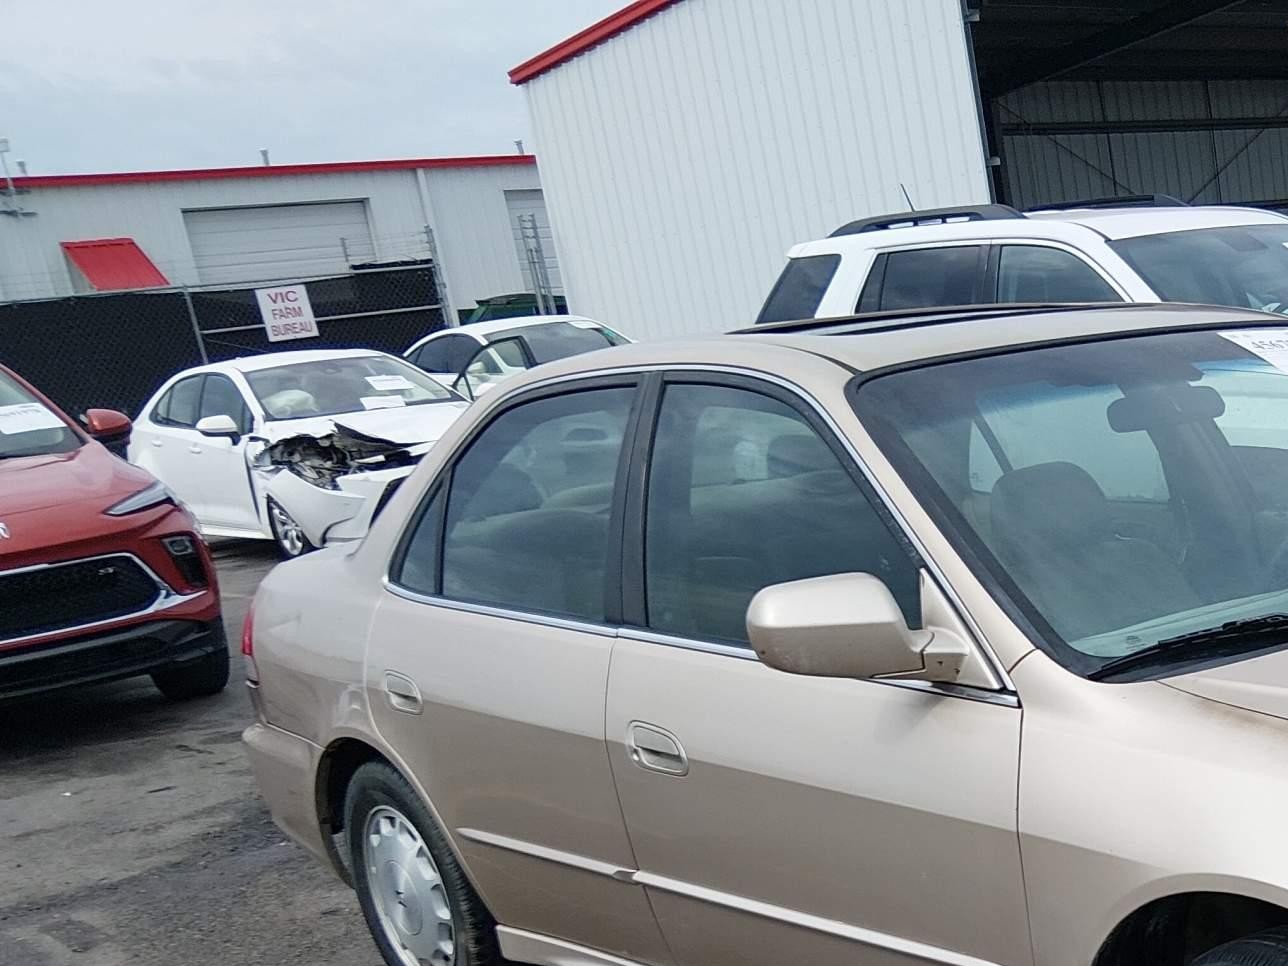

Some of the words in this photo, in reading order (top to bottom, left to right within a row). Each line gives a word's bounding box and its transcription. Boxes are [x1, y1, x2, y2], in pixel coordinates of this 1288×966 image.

[267, 290, 298, 304] VIC
[271, 306, 304, 320] FARM
[271, 321, 313, 337] BUREAU
